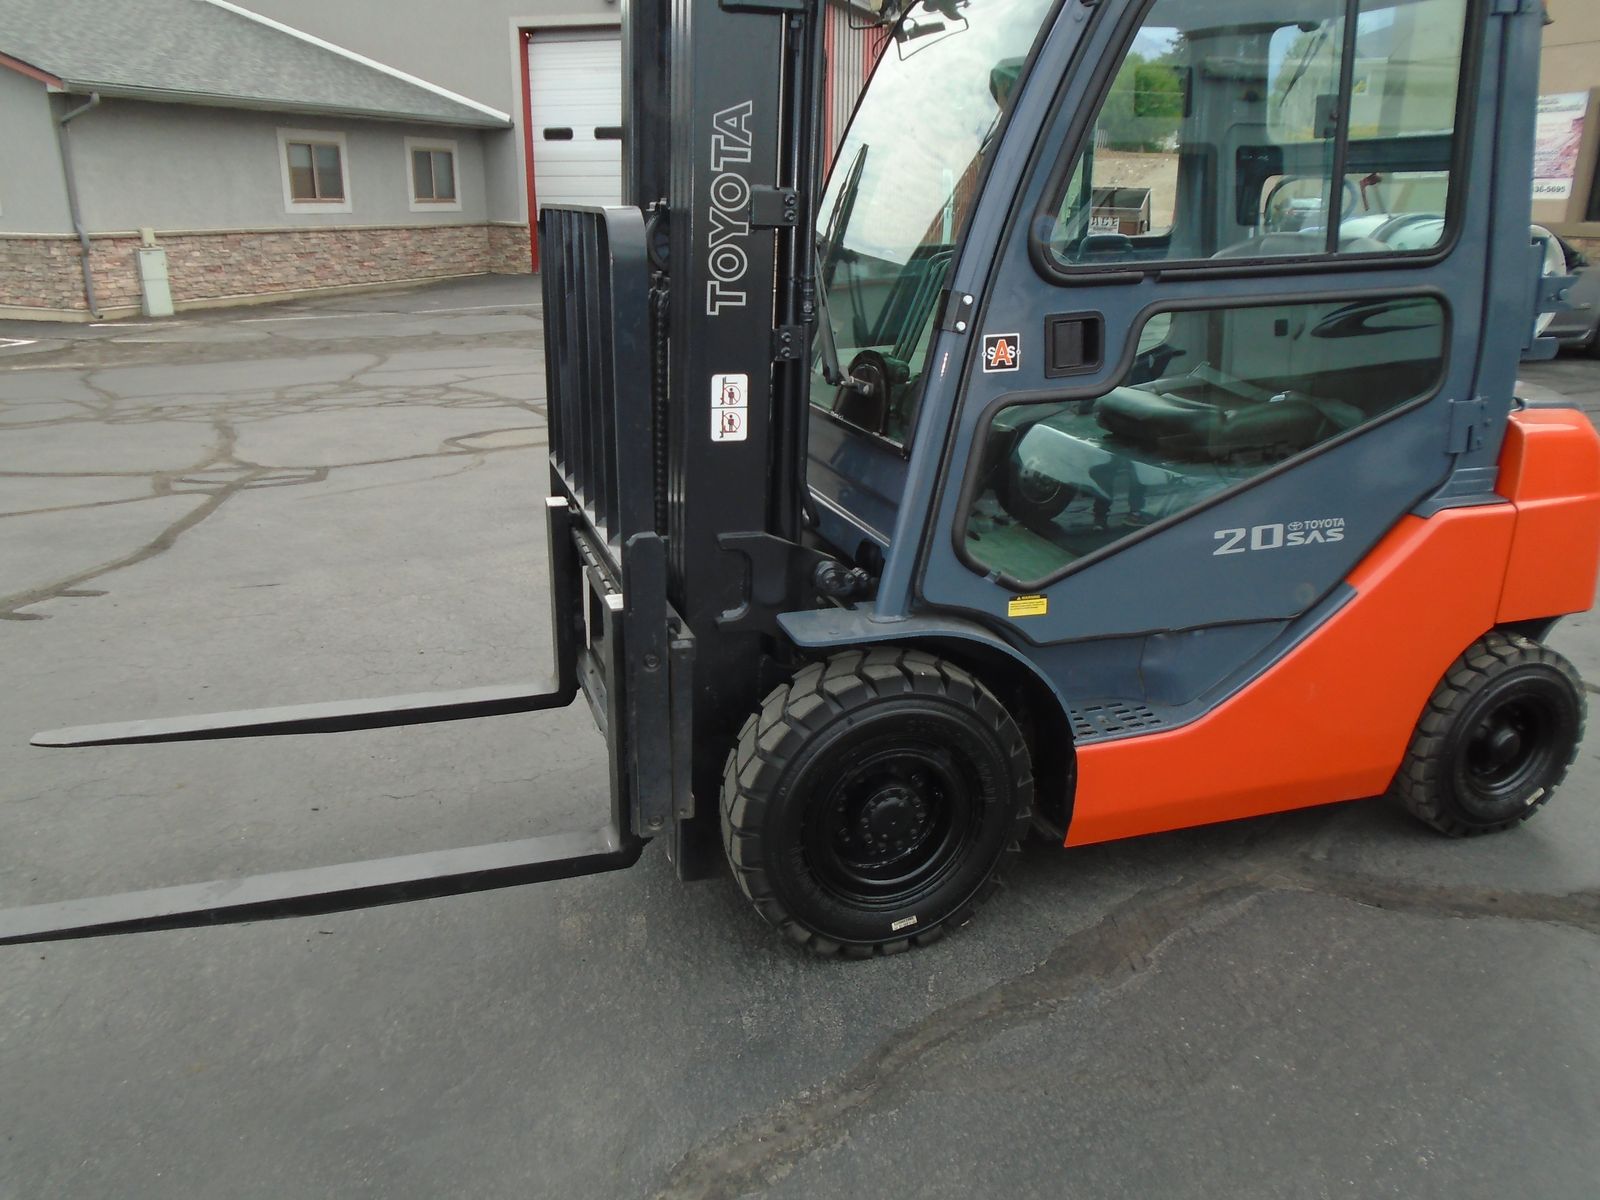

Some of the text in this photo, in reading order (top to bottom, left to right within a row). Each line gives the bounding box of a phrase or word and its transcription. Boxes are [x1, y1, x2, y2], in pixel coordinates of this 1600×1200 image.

[706, 100, 752, 315] TOYOTA
[987, 338, 1016, 366] SAS
[1304, 517, 1345, 530] TOYOTA
[1213, 523, 1345, 556] 20 SAS
